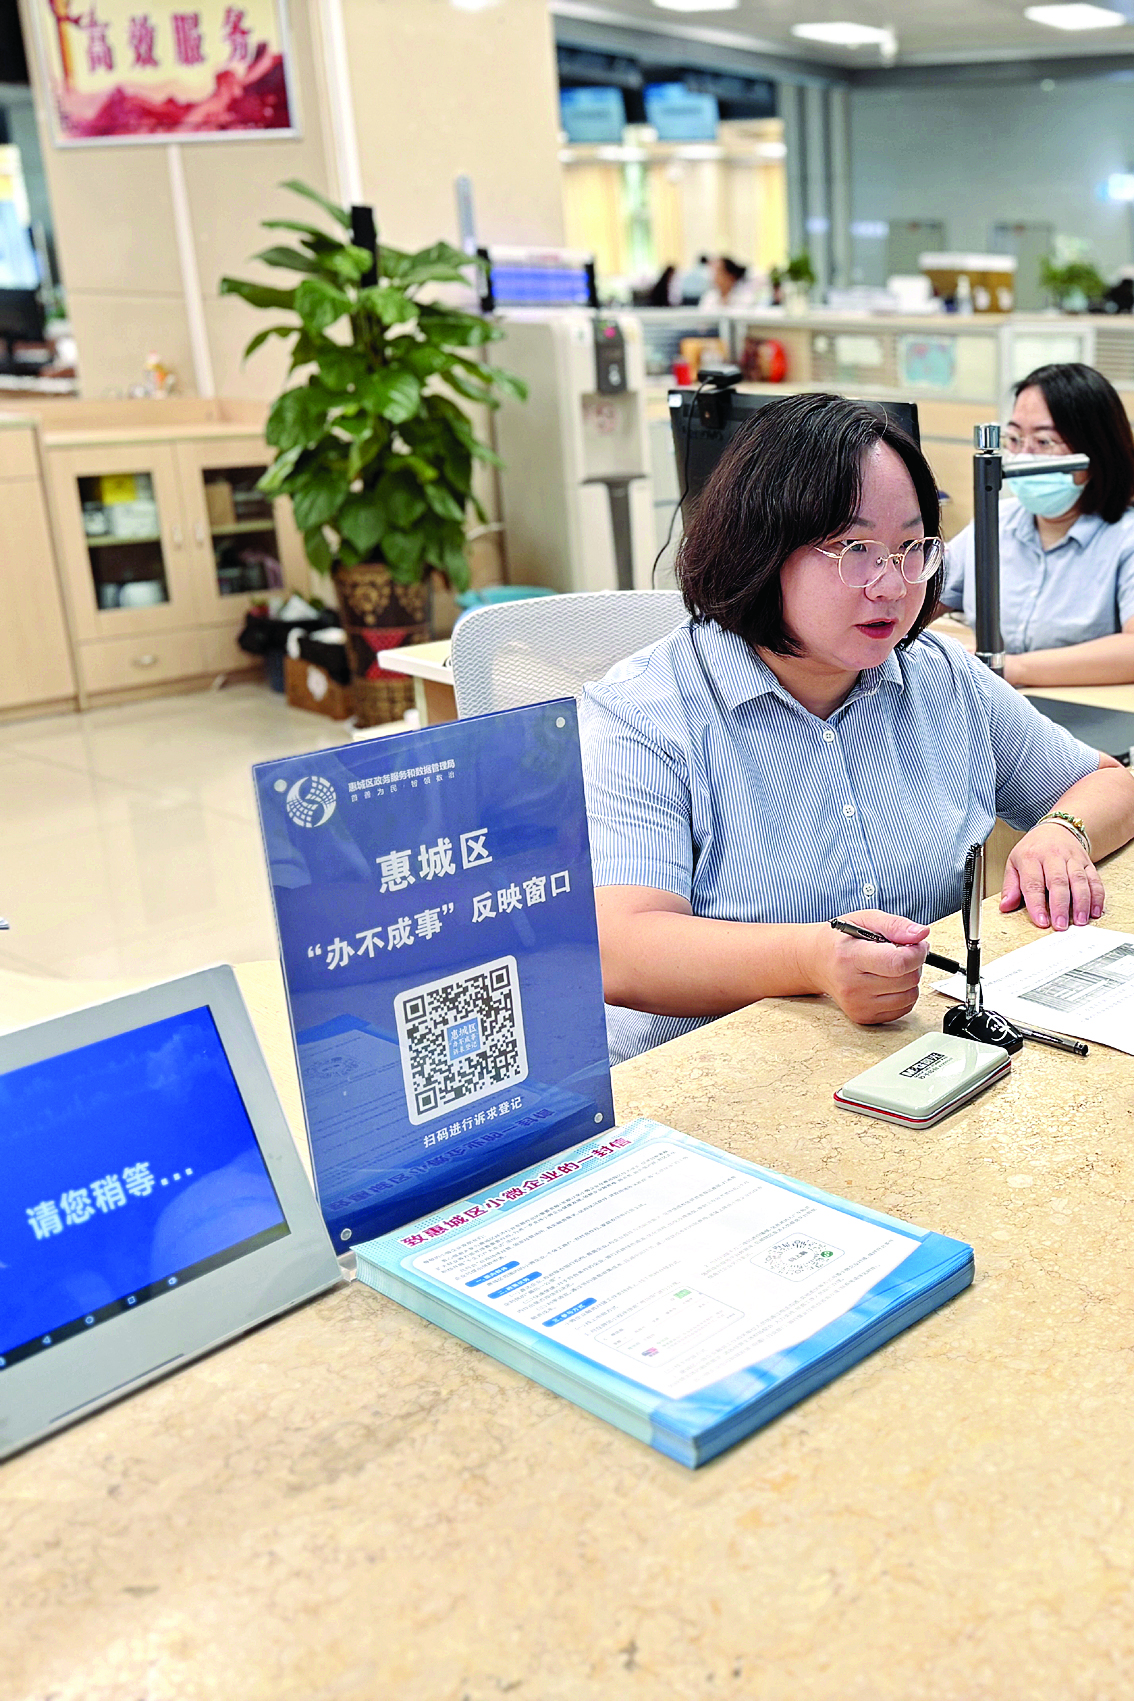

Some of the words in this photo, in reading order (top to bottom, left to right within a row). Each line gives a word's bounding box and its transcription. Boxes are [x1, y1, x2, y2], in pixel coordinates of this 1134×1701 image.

[83, 5, 250, 73] 高效服务
[348, 759, 456, 792] 惠城区政务服务和数据管理局
[376, 827, 493, 894] 惠城区
[423, 1096, 523, 1148] 扫码进行诉求登记
[400, 1136, 632, 1248] 致惠城区小微企业的一封信
